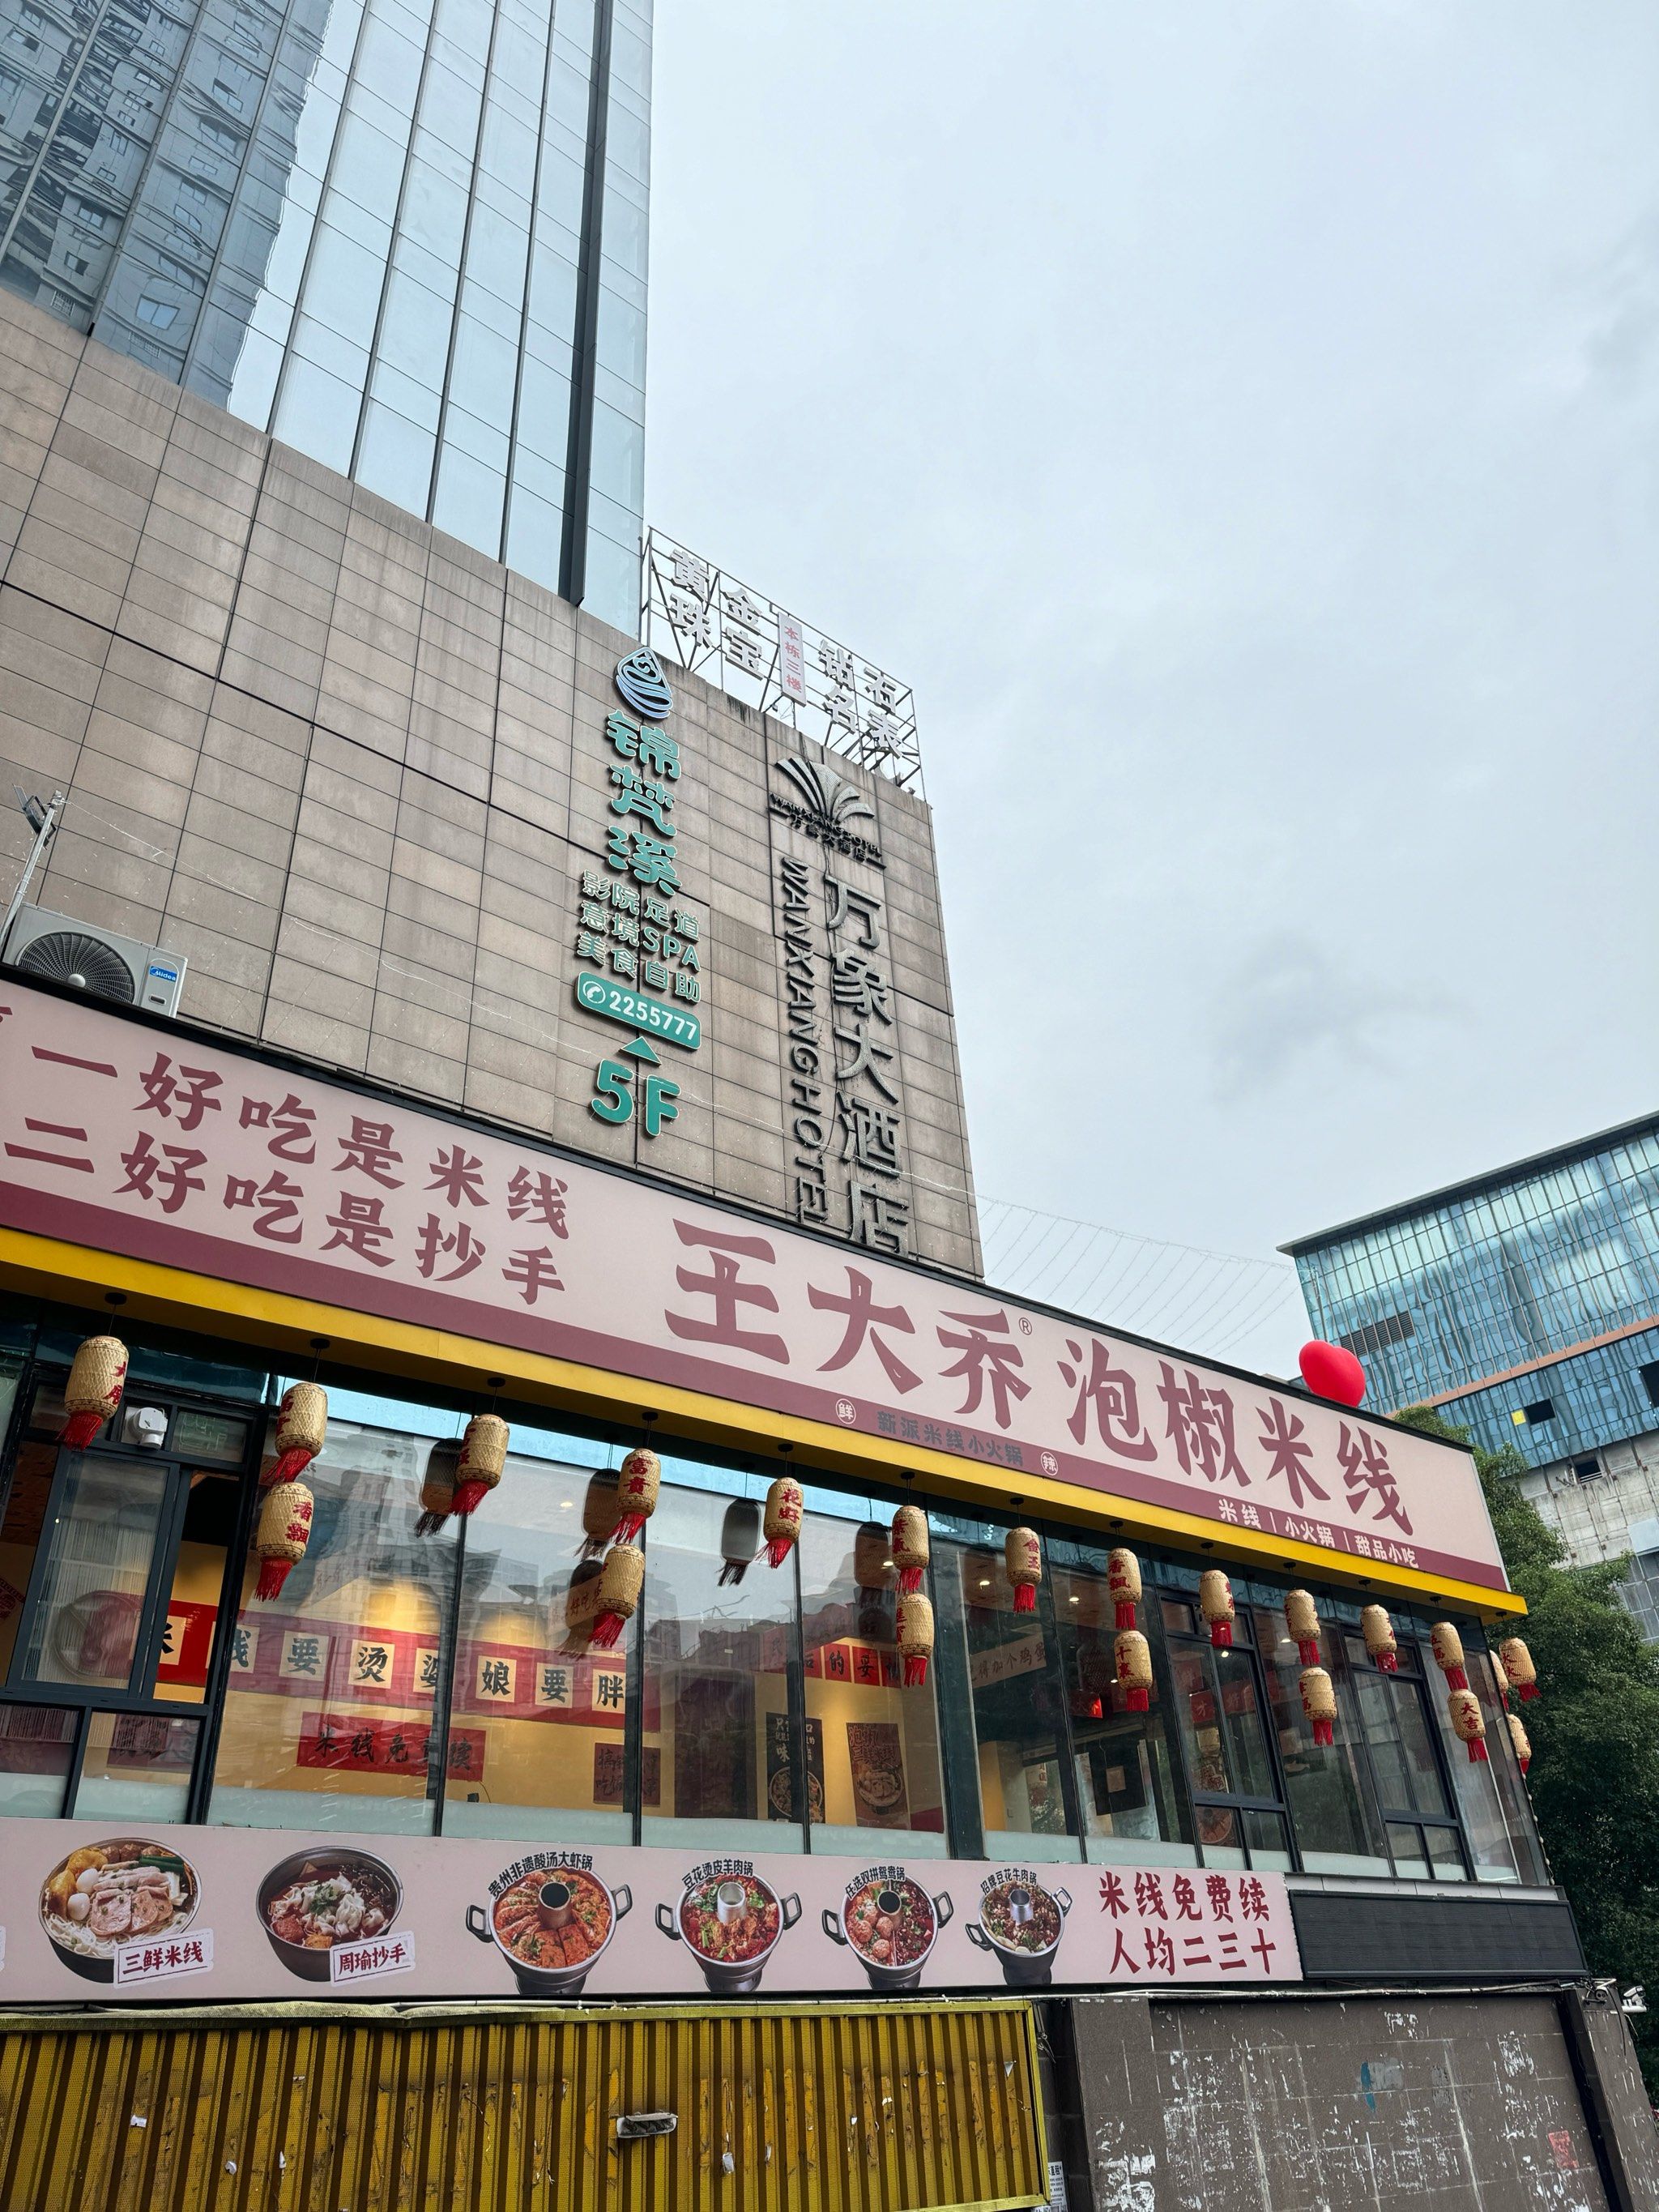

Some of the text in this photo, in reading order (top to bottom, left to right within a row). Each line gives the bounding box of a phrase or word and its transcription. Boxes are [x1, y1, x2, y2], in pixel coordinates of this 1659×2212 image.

[670, 549, 897, 716] 黄金 钻石
[784, 626, 803, 694] 本栋三楼
[670, 592, 902, 759] 珠宝 名表
[582, 869, 701, 942] 影院足道
[153, 967, 176, 981] Midea
[577, 931, 702, 1004] 美食自助
[610, 990, 697, 1040] 2255777
[825, 874, 909, 1258] 万象大酒店
[592, 1058, 682, 1137] 5F
[32, 1045, 569, 1240] 一好吃是米线
[4, 1117, 565, 1305] 二好吃是抄手
[877, 1411, 1024, 1467] 新派米线小火锅
[1218, 1498, 1419, 1569] 米线 小火锅 甜品小吃
[1461, 1702, 1479, 1731] 大吉
[488, 1851, 593, 1899] 贵州非遗酸汤大虾锅
[846, 1866, 906, 1898] 任选双拼鸳鸯锅
[980, 1868, 1038, 1895] 招牌豆花牛肉锅
[1099, 1871, 1269, 1923] 米线免费续
[123, 1941, 204, 1974] 三鲜米线
[339, 1944, 406, 1975] 周瑜抄手
[1109, 1927, 1277, 1976] 人均二三十
